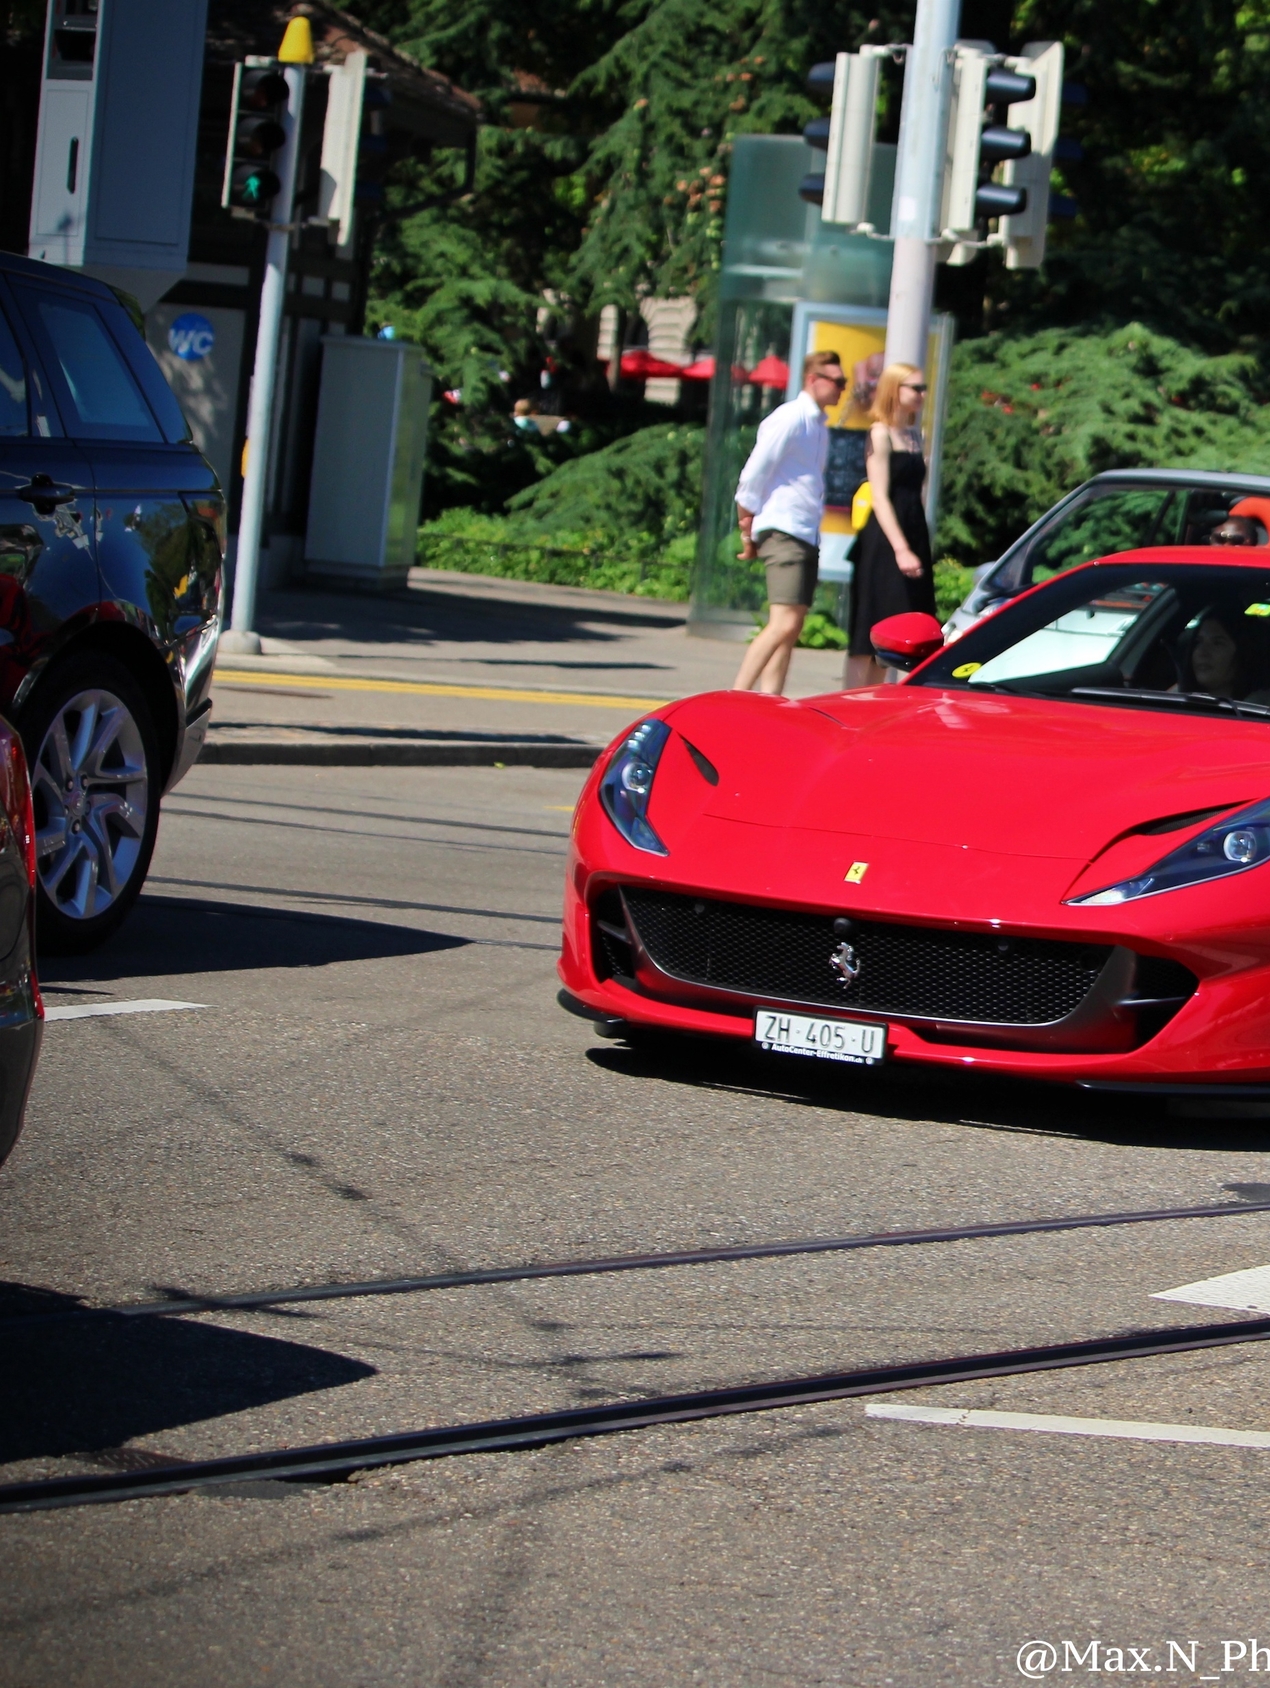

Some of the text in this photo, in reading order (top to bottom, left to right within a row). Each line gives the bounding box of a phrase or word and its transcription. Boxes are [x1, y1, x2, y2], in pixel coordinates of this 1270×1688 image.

[168, 328, 214, 355] WC
[765, 1015, 875, 1053] ZH 405 U
